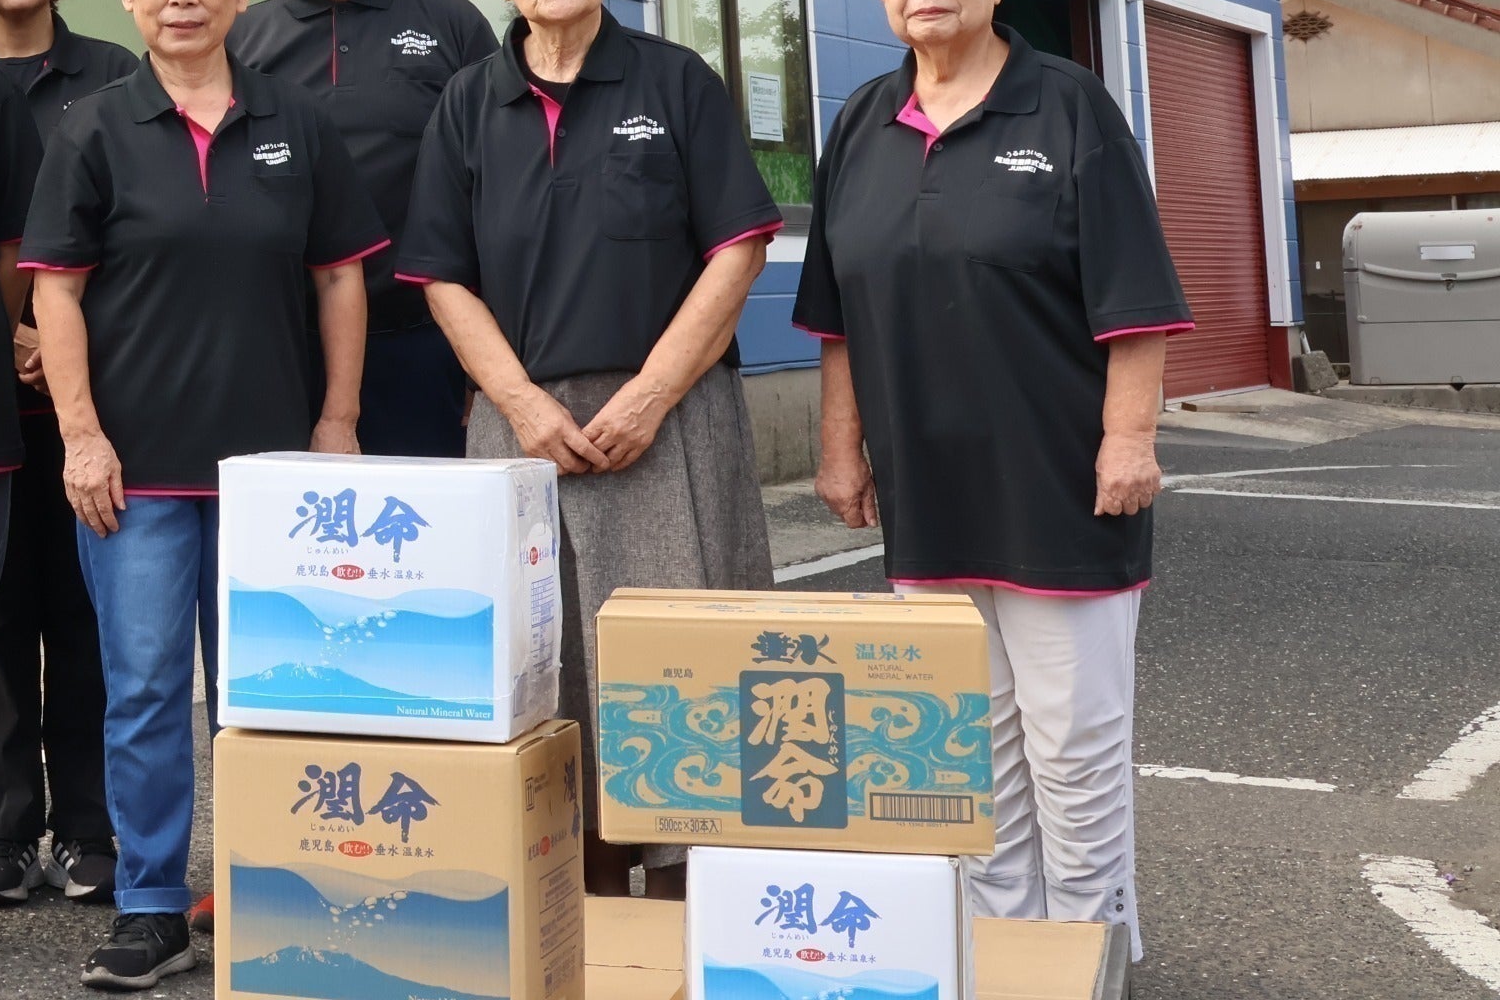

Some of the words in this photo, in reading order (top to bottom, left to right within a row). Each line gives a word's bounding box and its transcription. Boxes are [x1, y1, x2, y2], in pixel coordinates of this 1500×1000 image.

[288, 487, 432, 562] 潤命
[306, 546, 349, 555] じゅんめい
[295, 563, 330, 578] 鹿児島
[367, 567, 391, 580] 垂水
[393, 569, 425, 581] 温泉水
[855, 643, 923, 662] 温泉水
[663, 667, 694, 679] 鹿児島
[867, 664, 905, 672] NATURAL
[867, 672, 902, 680] MINERAL
[905, 673, 934, 681] WATER
[396, 705, 428, 716] Natural
[430, 707, 464, 718] Mineral
[466, 708, 492, 719] Water
[827, 709, 840, 765] じゅんめい
[747, 676, 839, 823] 潤命
[290, 762, 441, 843] 潤命
[309, 822, 355, 833] じゅんめい
[658, 817, 720, 833] 500cc×30本入
[298, 838, 335, 852] 鹿児島
[374, 843, 400, 857] 垂水
[402, 846, 435, 858] 温泉水
[754, 883, 882, 949] 潤命
[770, 932, 810, 941] じゅんめい
[761, 947, 793, 959] 鹿児島
[826, 951, 848, 963] 垂水
[849, 953, 877, 964] 温泉水
